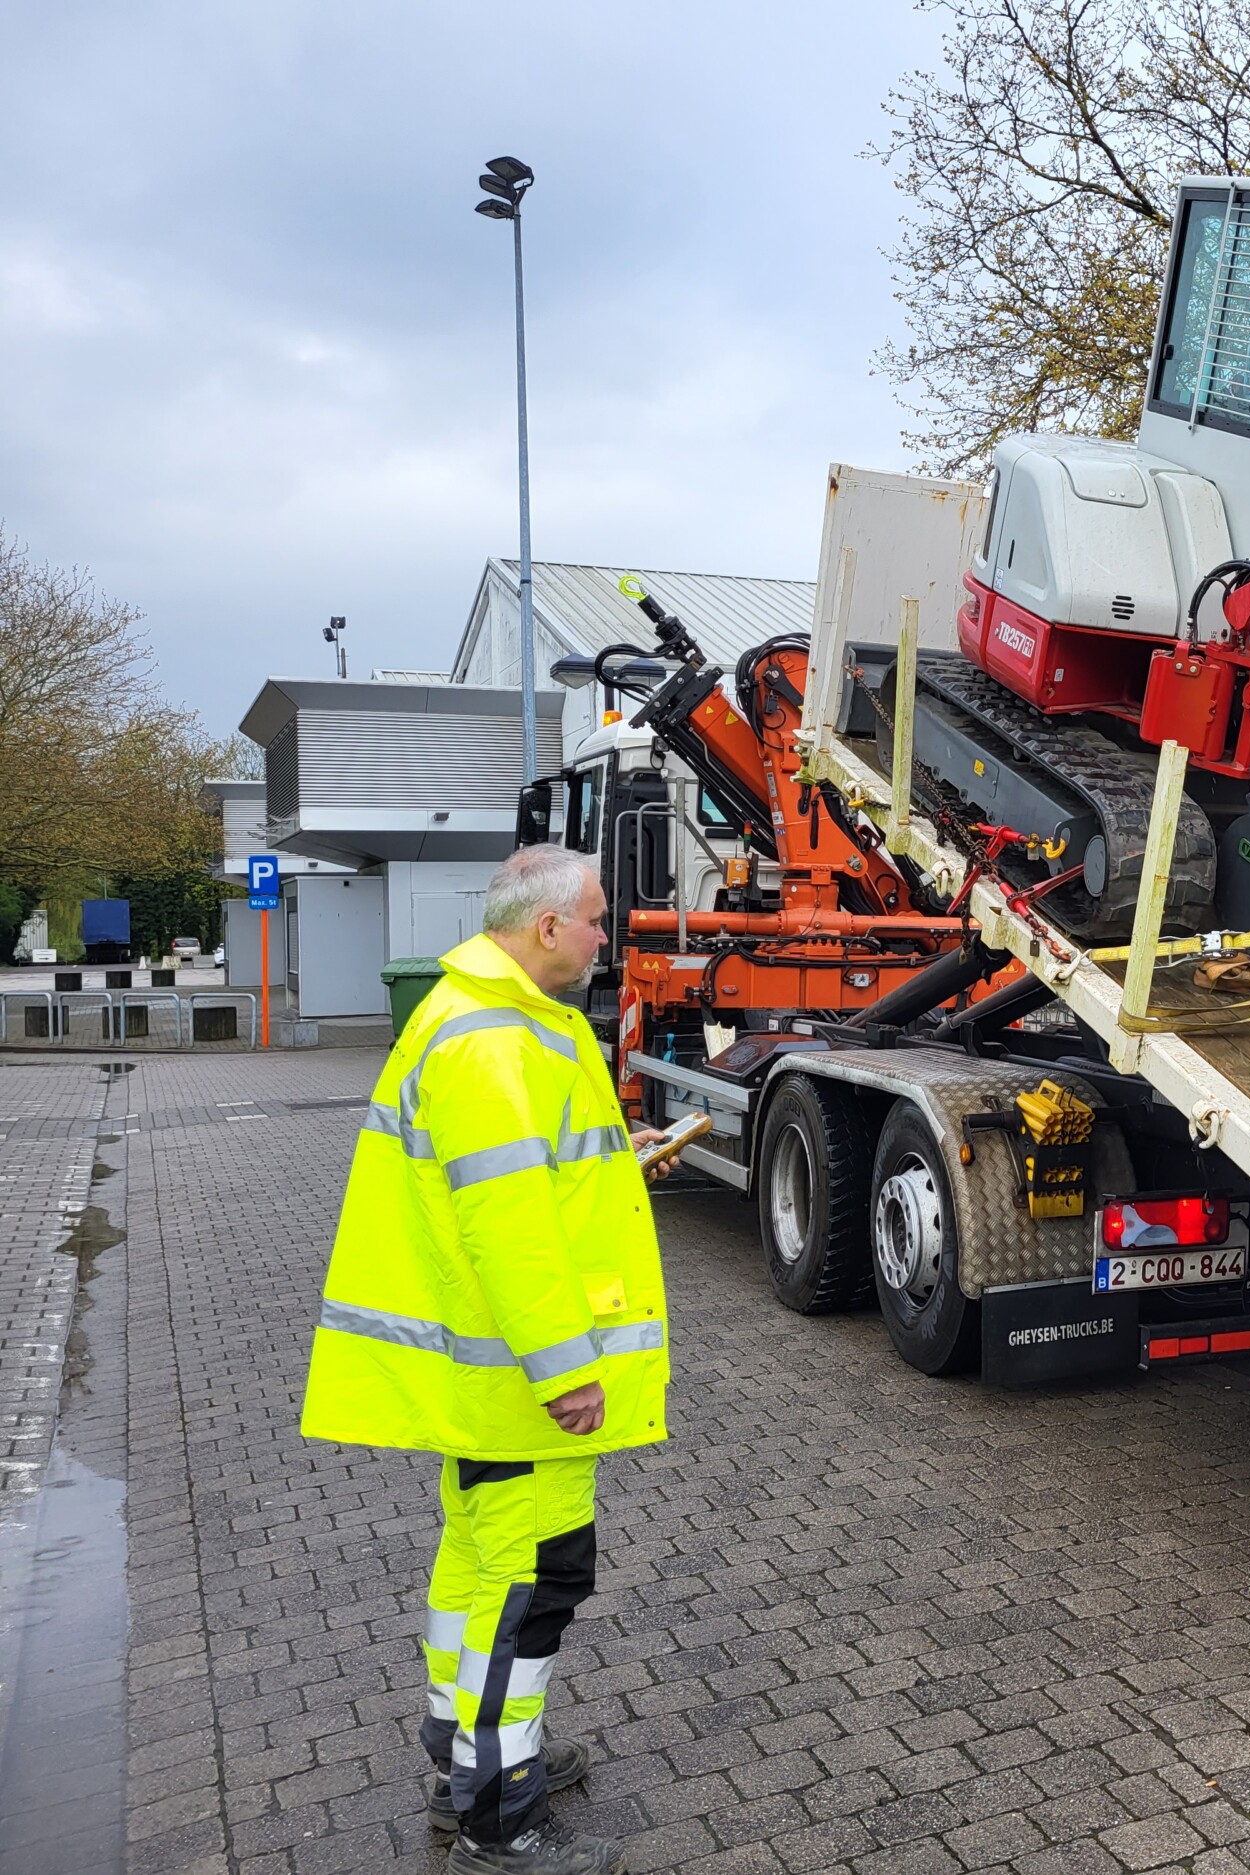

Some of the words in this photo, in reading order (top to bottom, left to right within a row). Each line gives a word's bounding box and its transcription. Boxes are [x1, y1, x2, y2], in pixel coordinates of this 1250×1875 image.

[253, 862, 274, 889] P
[1098, 1277, 1107, 1289] B
[1008, 1318, 1114, 1346] GHEYSEN-TRUCKS.BE
